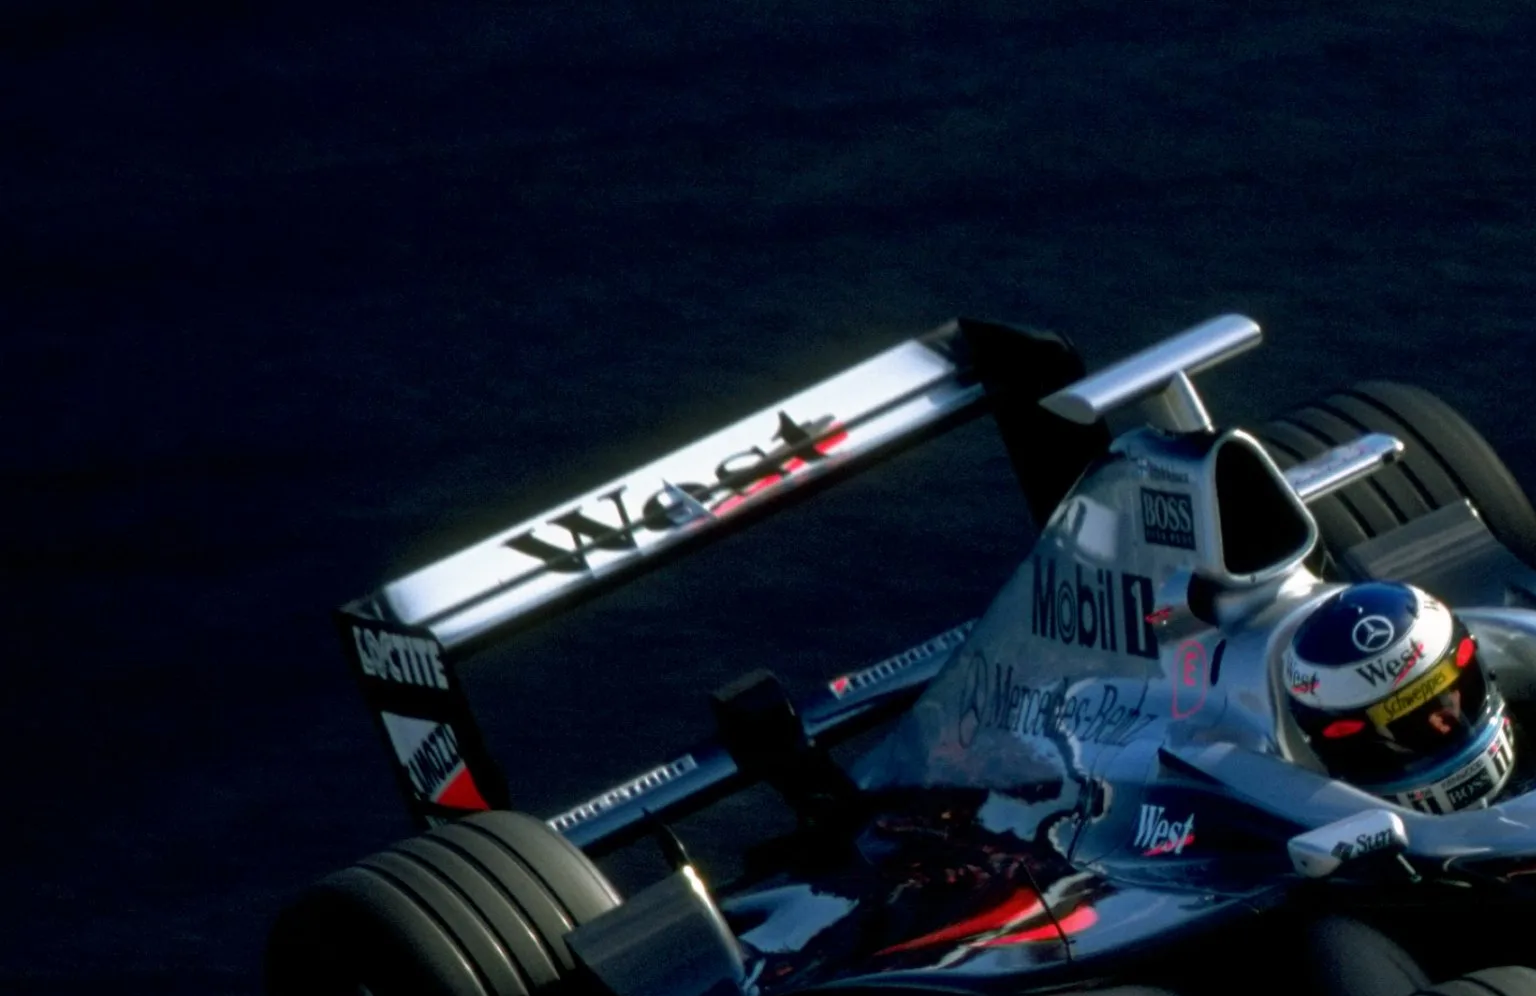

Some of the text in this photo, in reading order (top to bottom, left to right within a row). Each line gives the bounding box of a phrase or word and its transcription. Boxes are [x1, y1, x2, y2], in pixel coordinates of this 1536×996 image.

[501, 411, 838, 574] West
[1143, 494, 1192, 533] BOSS
[1032, 553, 1118, 652] Mobil
[1356, 639, 1426, 688] West
[1133, 803, 1197, 856] West
